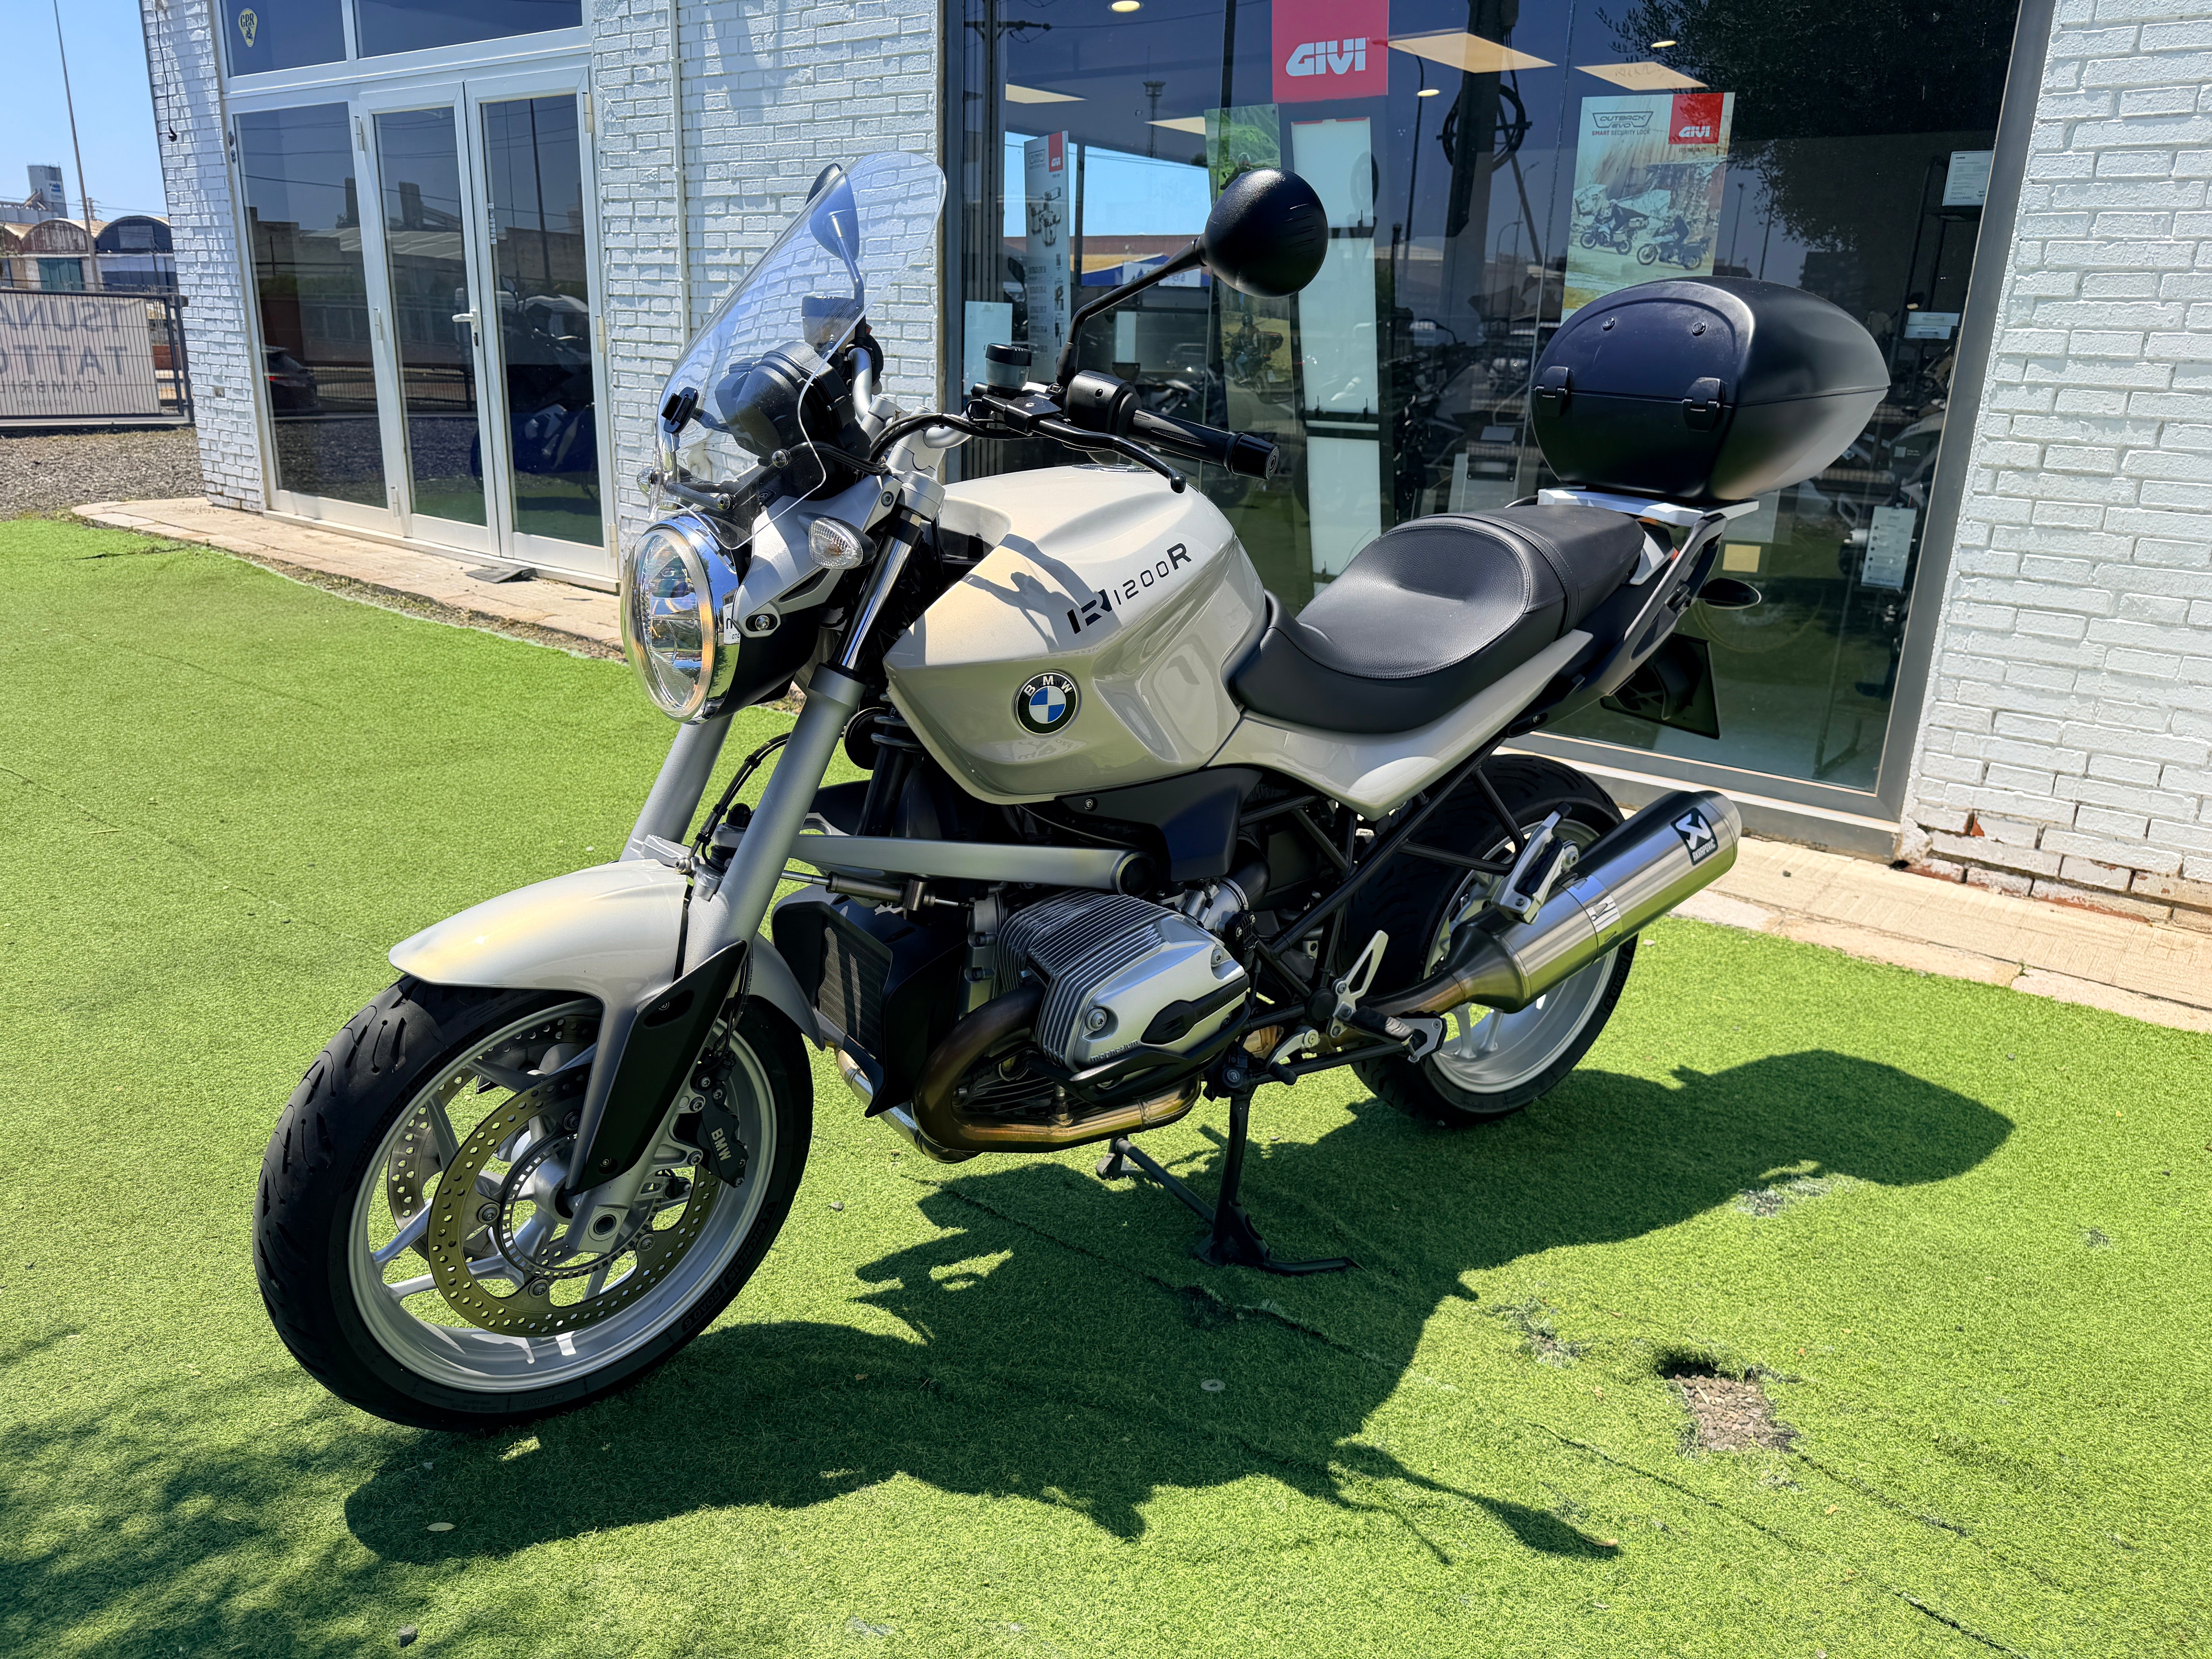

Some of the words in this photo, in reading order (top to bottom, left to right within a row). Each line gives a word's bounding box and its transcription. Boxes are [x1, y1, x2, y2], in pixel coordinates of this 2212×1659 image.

[240, 13, 254, 27] GPR
[1286, 38, 1366, 76] GIVI
[1679, 126, 1711, 137] GIVI
[1024, 675, 1072, 697] BMW
[711, 1127, 732, 1161] BMW
[728, 1221, 767, 1282] MICHELIN
[694, 1288, 721, 1318] ROAD
[684, 1318, 693, 1328] 6
[523, 1395, 555, 1407] FRONT
